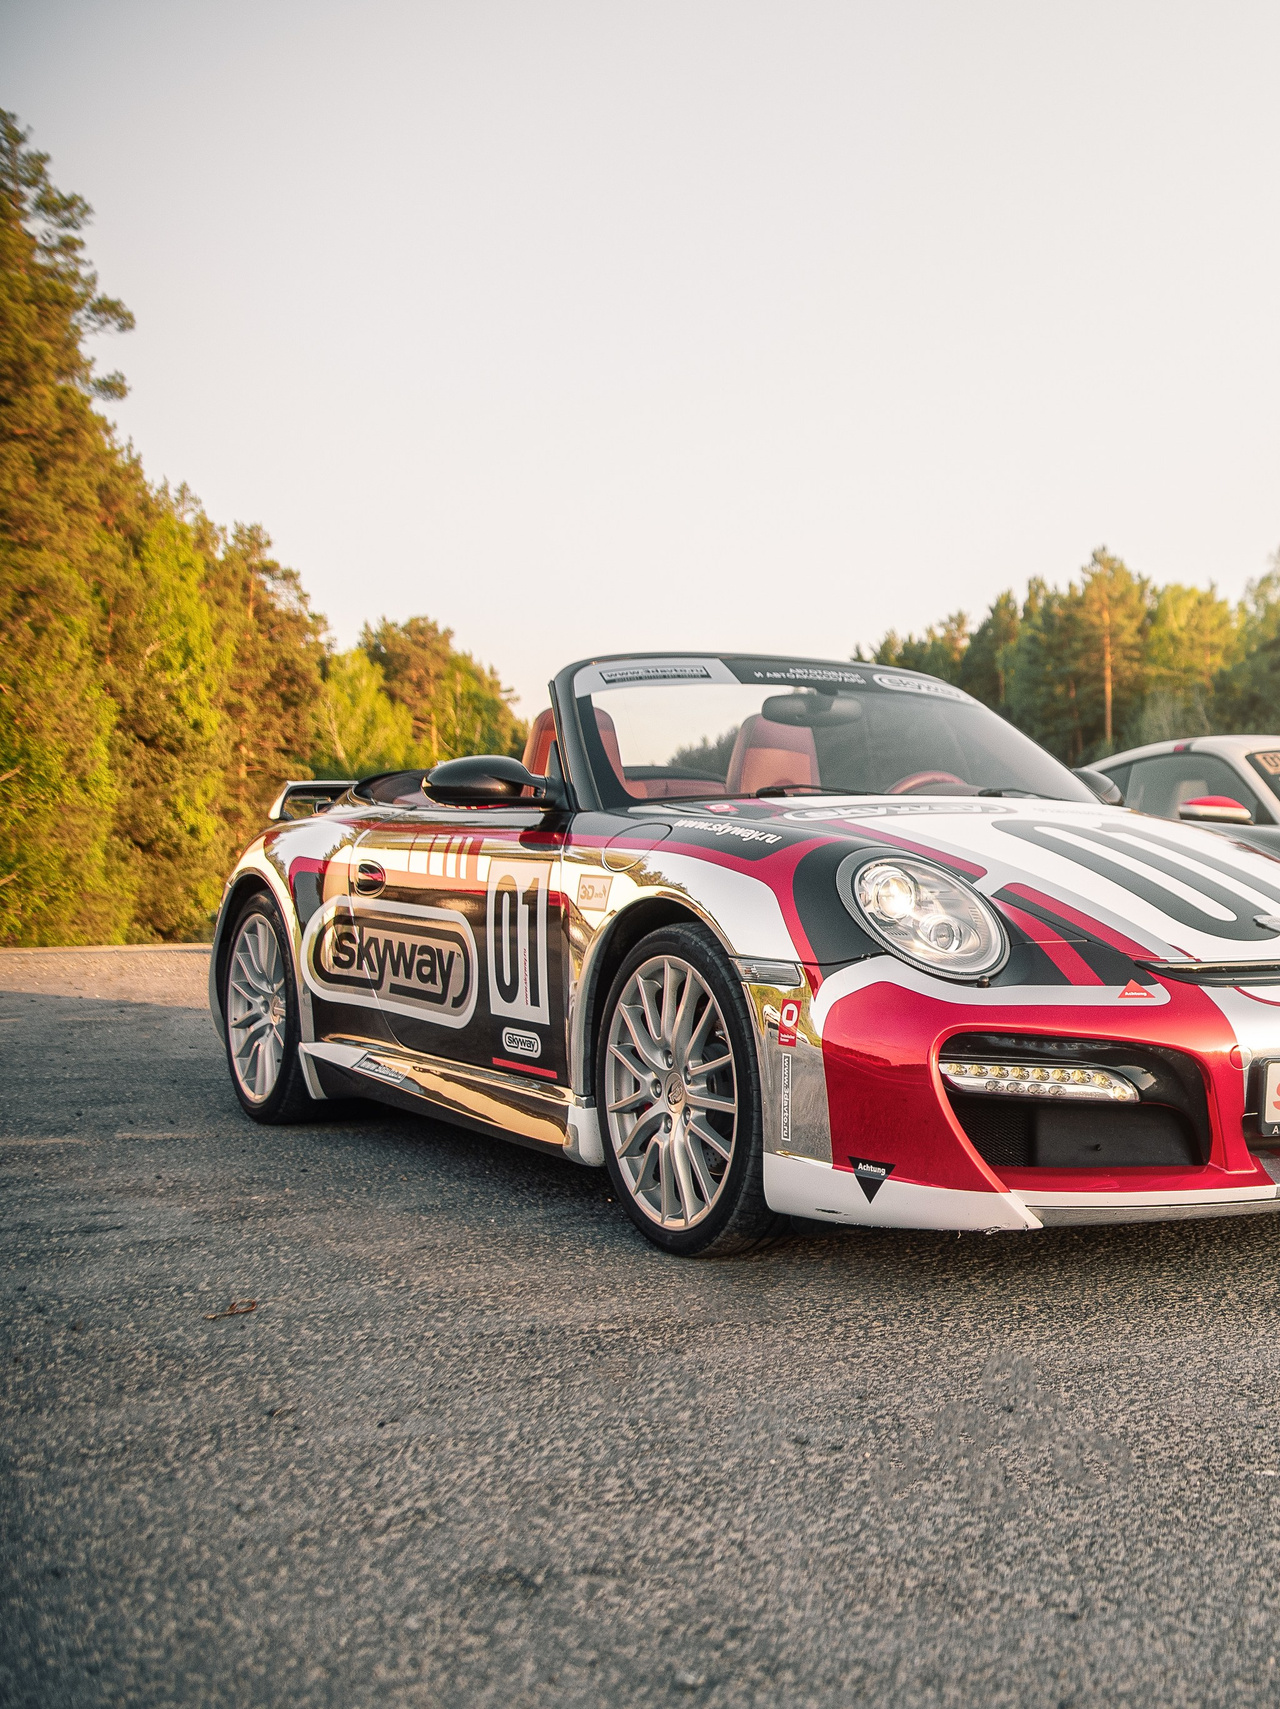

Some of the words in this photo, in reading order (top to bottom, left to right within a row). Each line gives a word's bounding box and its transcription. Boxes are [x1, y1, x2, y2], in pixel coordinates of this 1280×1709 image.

[674, 819, 783, 844] www.skyway.ru
[494, 874, 542, 1008] 01
[332, 925, 456, 1000] skyway
[507, 1033, 537, 1052] skyway
[857, 1162, 886, 1175] Achtung
